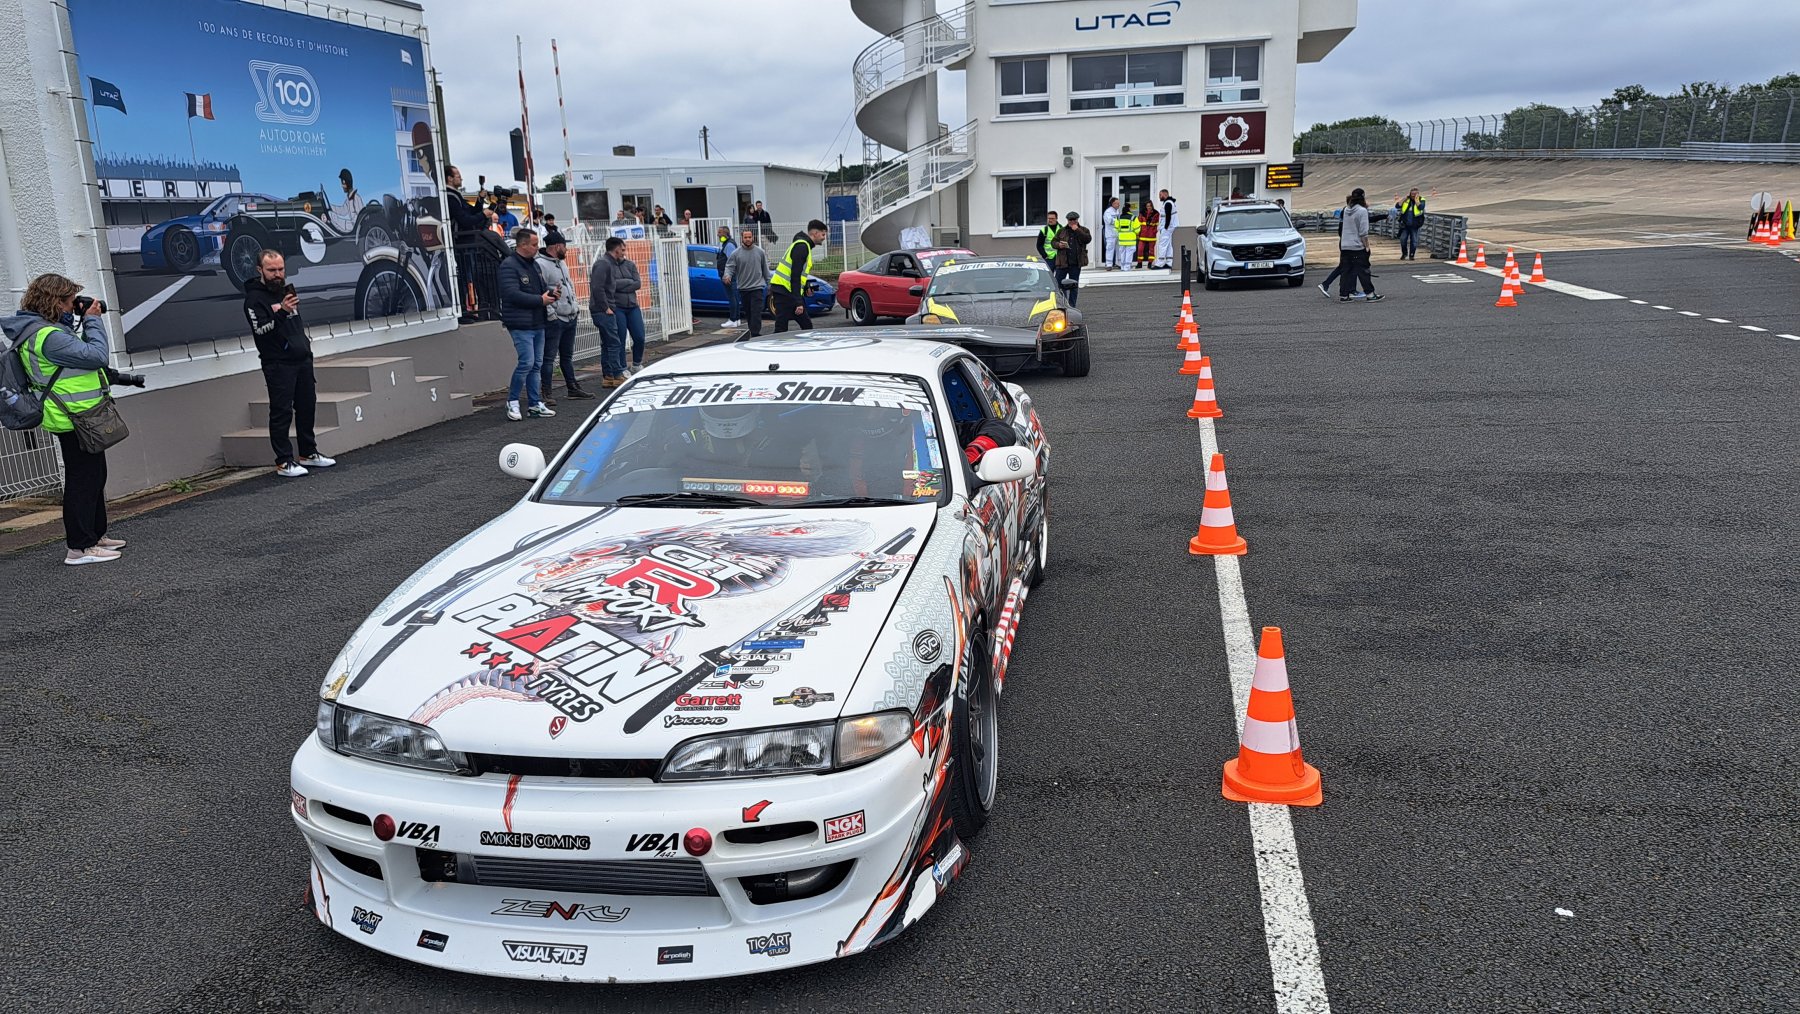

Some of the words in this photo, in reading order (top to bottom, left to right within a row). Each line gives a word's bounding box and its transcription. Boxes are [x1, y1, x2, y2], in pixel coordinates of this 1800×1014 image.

[1075, 11, 1171, 31] UTAC
[198, 20, 216, 34] 100
[220, 24, 238, 38] ANS
[242, 29, 253, 40] DE
[256, 32, 294, 48] RECORDS
[297, 40, 305, 49] ET
[308, 42, 349, 56] D'HISTOIRE
[275, 78, 312, 108] 100
[260, 128, 326, 145] AUTODROME
[390, 370, 396, 386] 1
[430, 387, 437, 402] 3
[661, 382, 742, 406] Drift
[774, 381, 865, 403] Show
[355, 405, 363, 421] 2
[450, 593, 683, 704] PLATIN
[524, 672, 604, 722] TYRES
[674, 694, 742, 706] Garrett
[396, 820, 441, 846] VBA
[827, 814, 862, 836] NGK
[480, 832, 520, 846] SMOKE
[522, 833, 533, 847] IS
[534, 834, 591, 850] COMING
[625, 832, 680, 857] VBA
[768, 947, 790, 956] STUDIO
